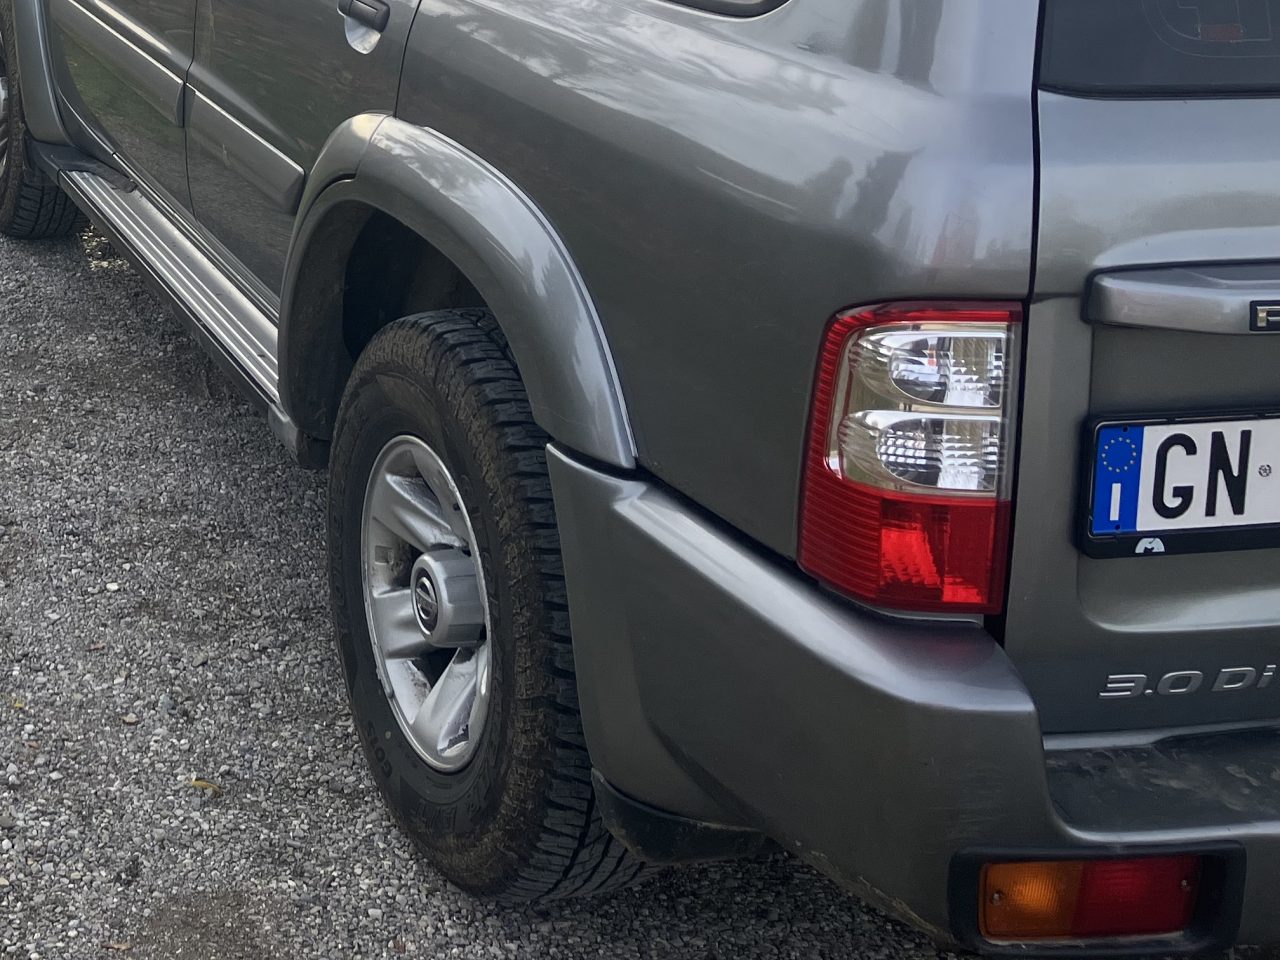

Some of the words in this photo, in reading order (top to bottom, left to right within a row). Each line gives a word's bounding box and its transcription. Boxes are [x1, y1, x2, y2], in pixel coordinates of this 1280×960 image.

[1152, 429, 1252, 519] GN
[1109, 482, 1122, 521] I
[1099, 671, 1203, 698] 3.0
[1211, 664, 1277, 692] Di
